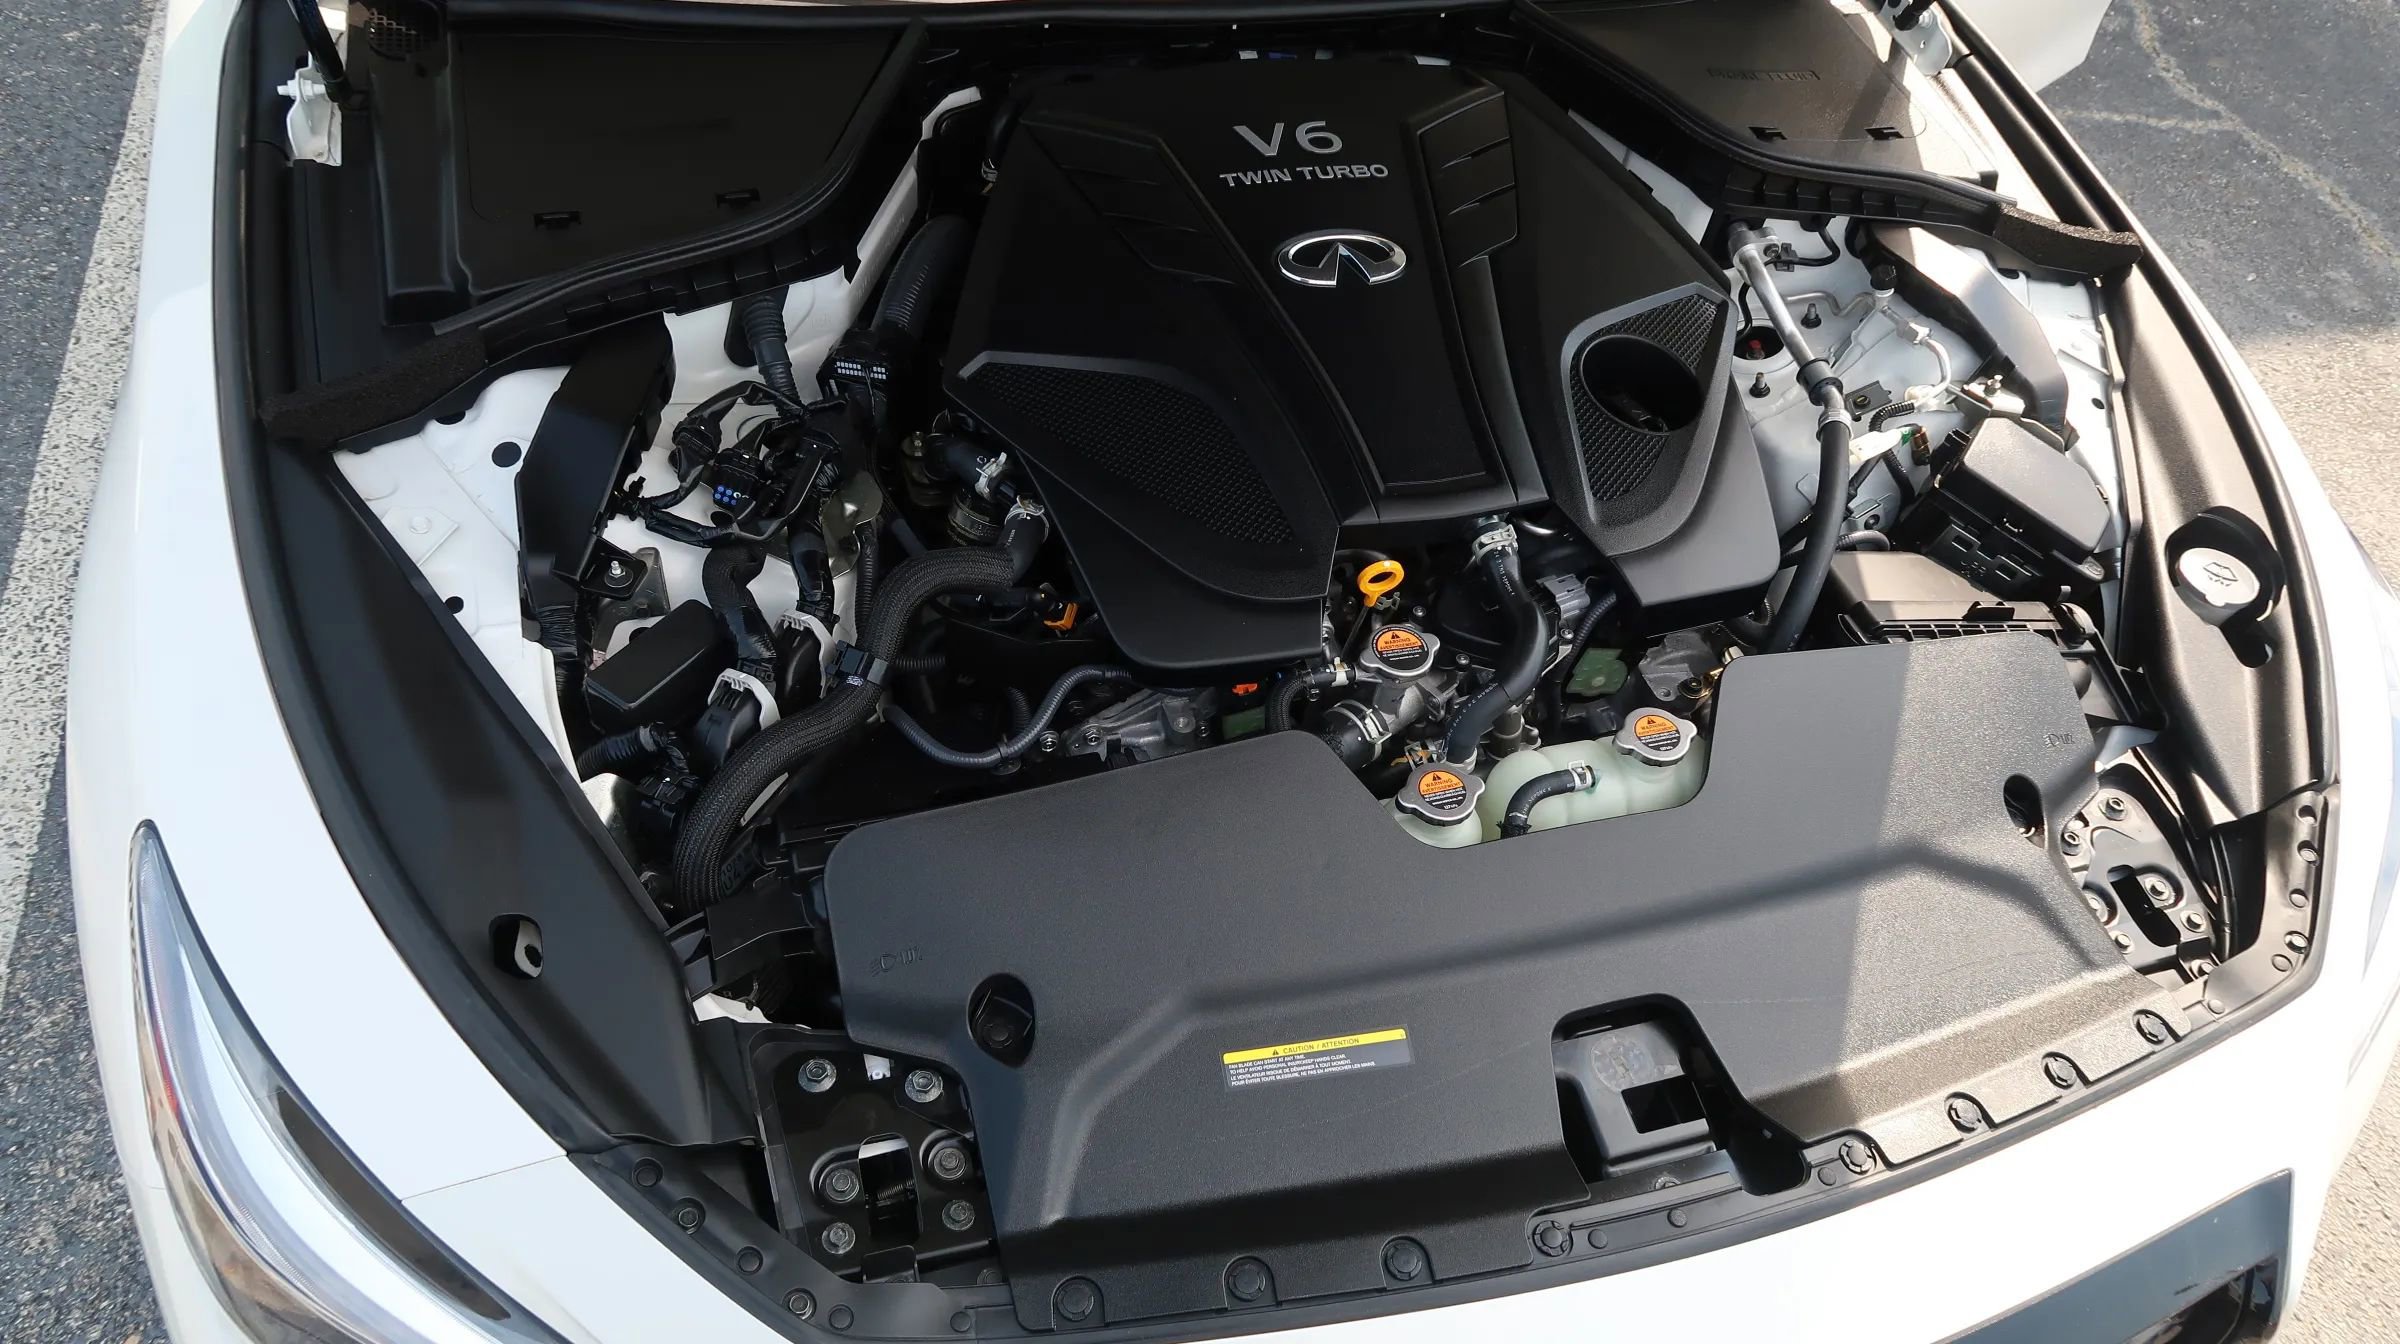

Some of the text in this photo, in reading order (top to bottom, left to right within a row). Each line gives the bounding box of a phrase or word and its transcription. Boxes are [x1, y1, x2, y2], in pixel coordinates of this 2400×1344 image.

[1233, 120, 1343, 157] V6
[1219, 164, 1389, 187] TWIN TURBO
[1424, 778, 1453, 788] WARNING
[1282, 1044, 1314, 1054] CAUTION
[1321, 1038, 1359, 1048] ATTENTION
